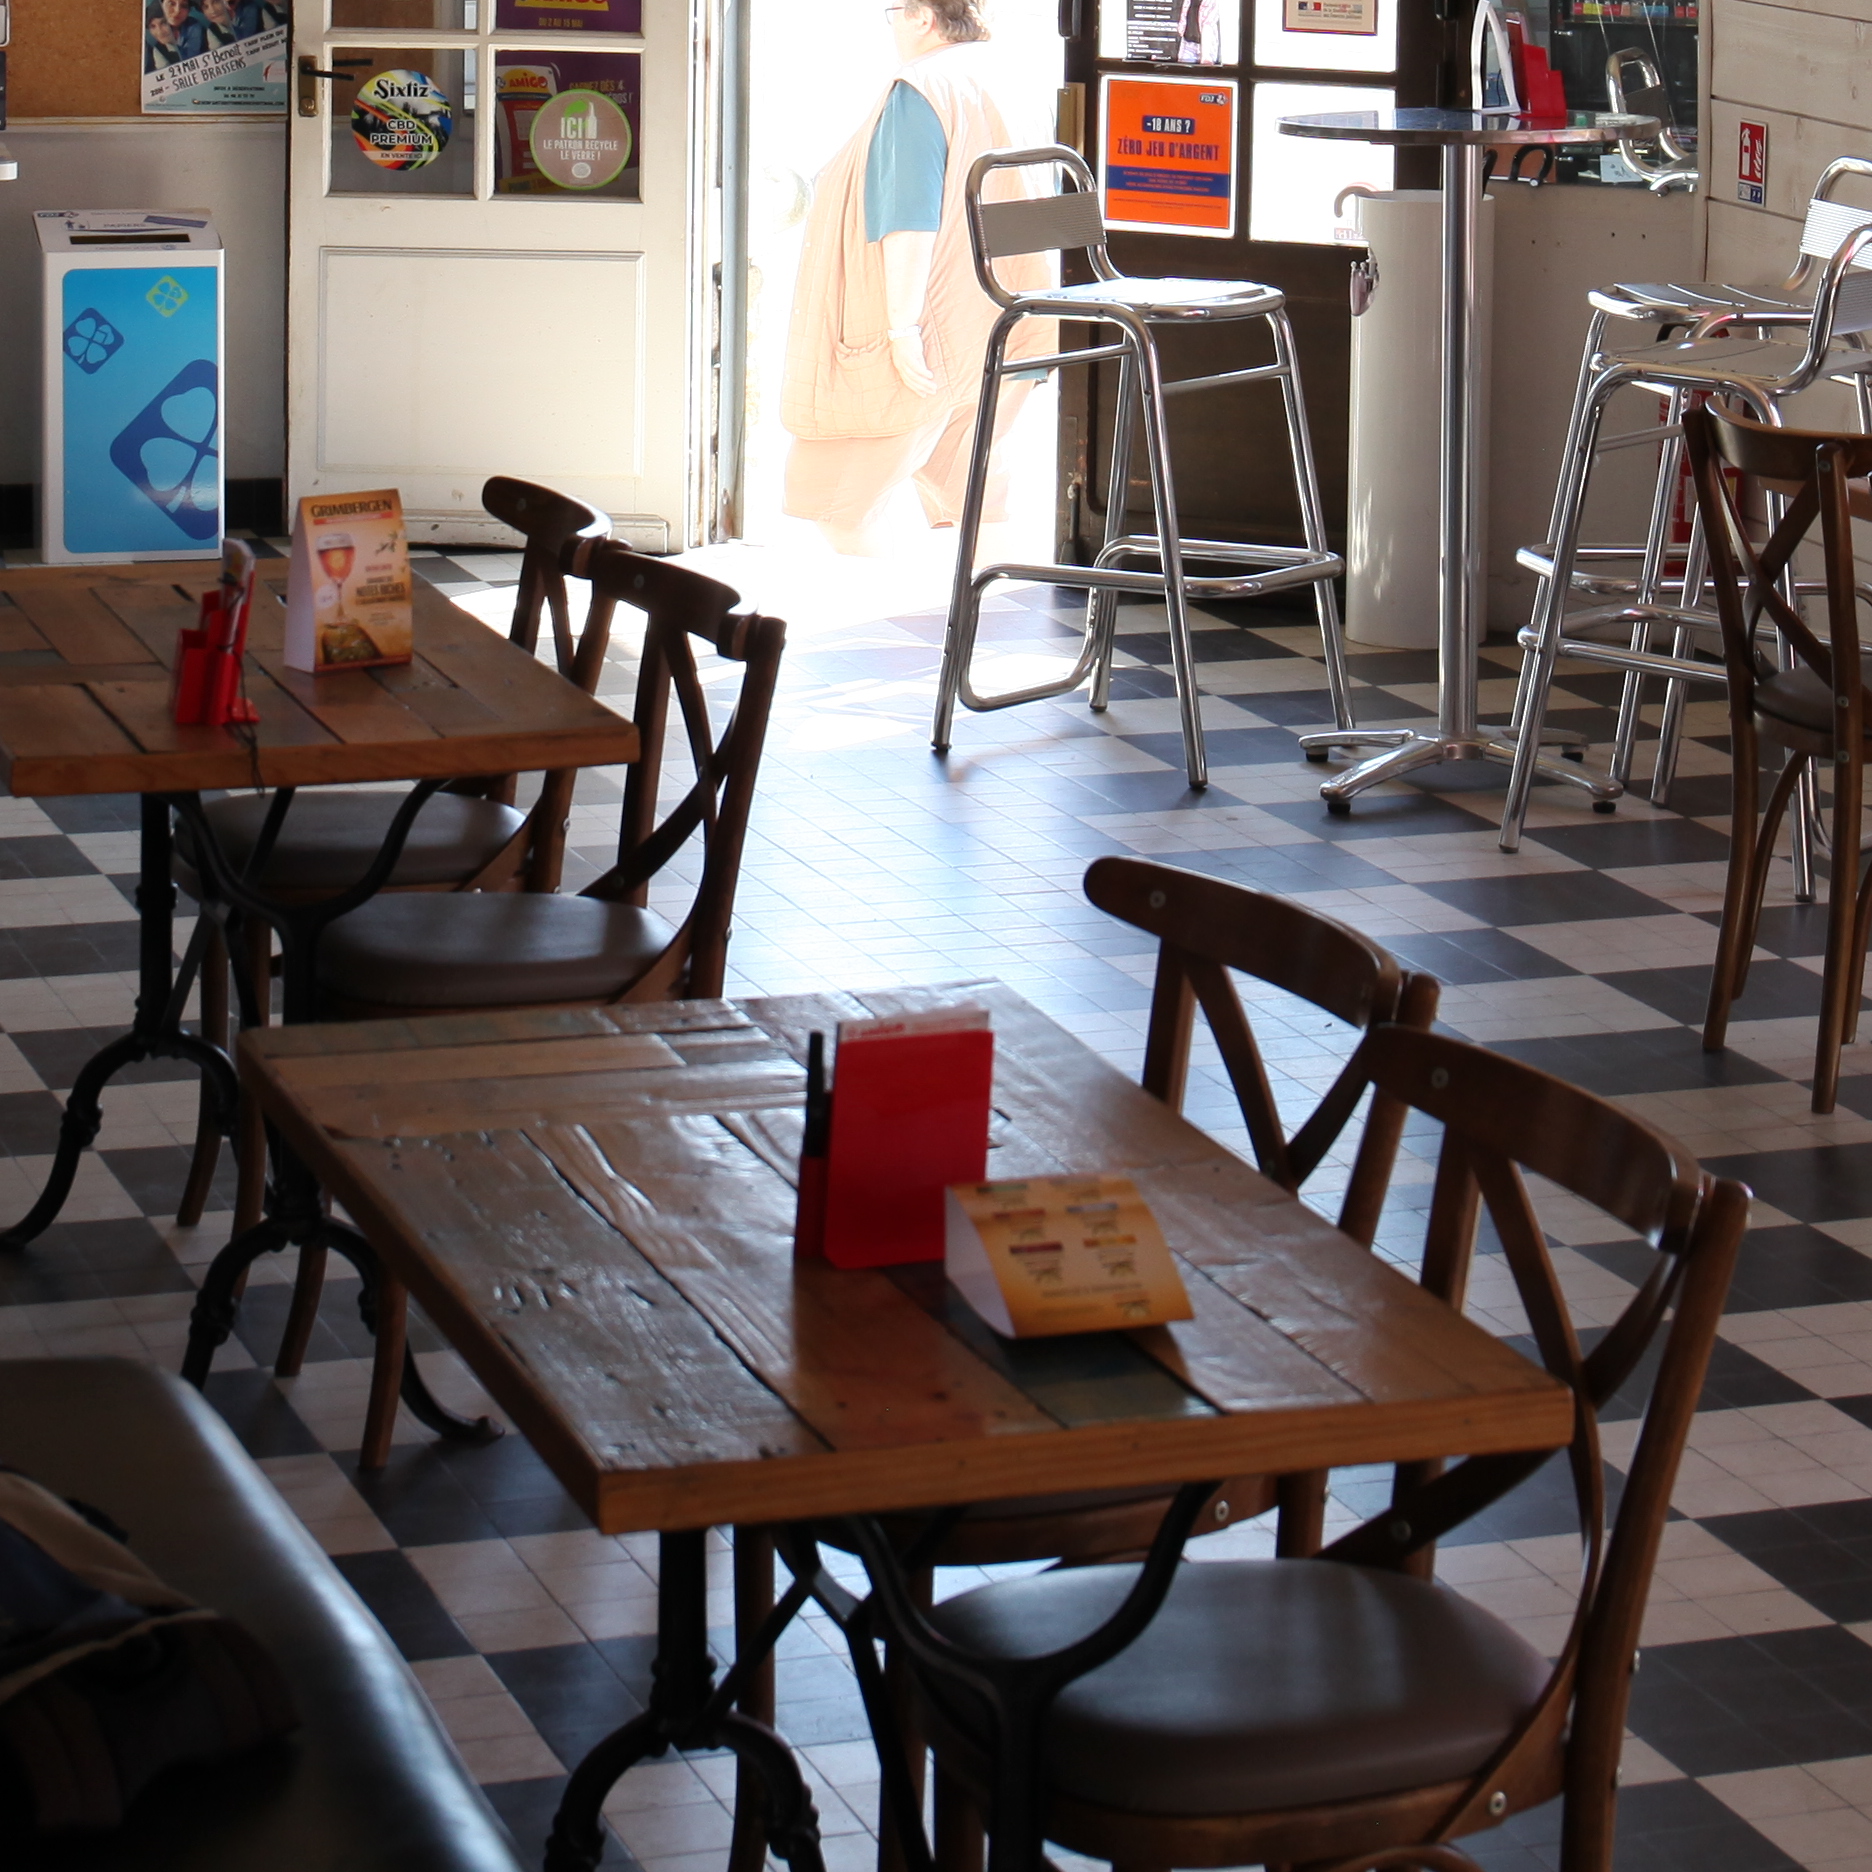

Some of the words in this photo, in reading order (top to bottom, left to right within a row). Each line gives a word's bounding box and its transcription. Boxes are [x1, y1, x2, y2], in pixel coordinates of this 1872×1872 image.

[202, 56, 247, 81] BRASSENS
[509, 72, 548, 88] AMIGO
[373, 79, 430, 100] Sixtiz
[386, 118, 417, 131] CBD
[560, 117, 583, 139] ICI
[1146, 117, 1162, 133] -18
[1164, 118, 1182, 133] ANS
[370, 132, 433, 146] PREMIUM
[543, 139, 553, 150] LE
[554, 139, 583, 150] PATRON
[584, 140, 618, 151] RECYCLE
[560, 150, 569, 161] LE
[570, 150, 596, 161] VERRE
[1117, 135, 1143, 156] ZÉRO
[1146, 140, 1165, 157] JEU
[1168, 142, 1220, 161] D'ARGENT
[310, 499, 393, 518] GRIMBERGEN
